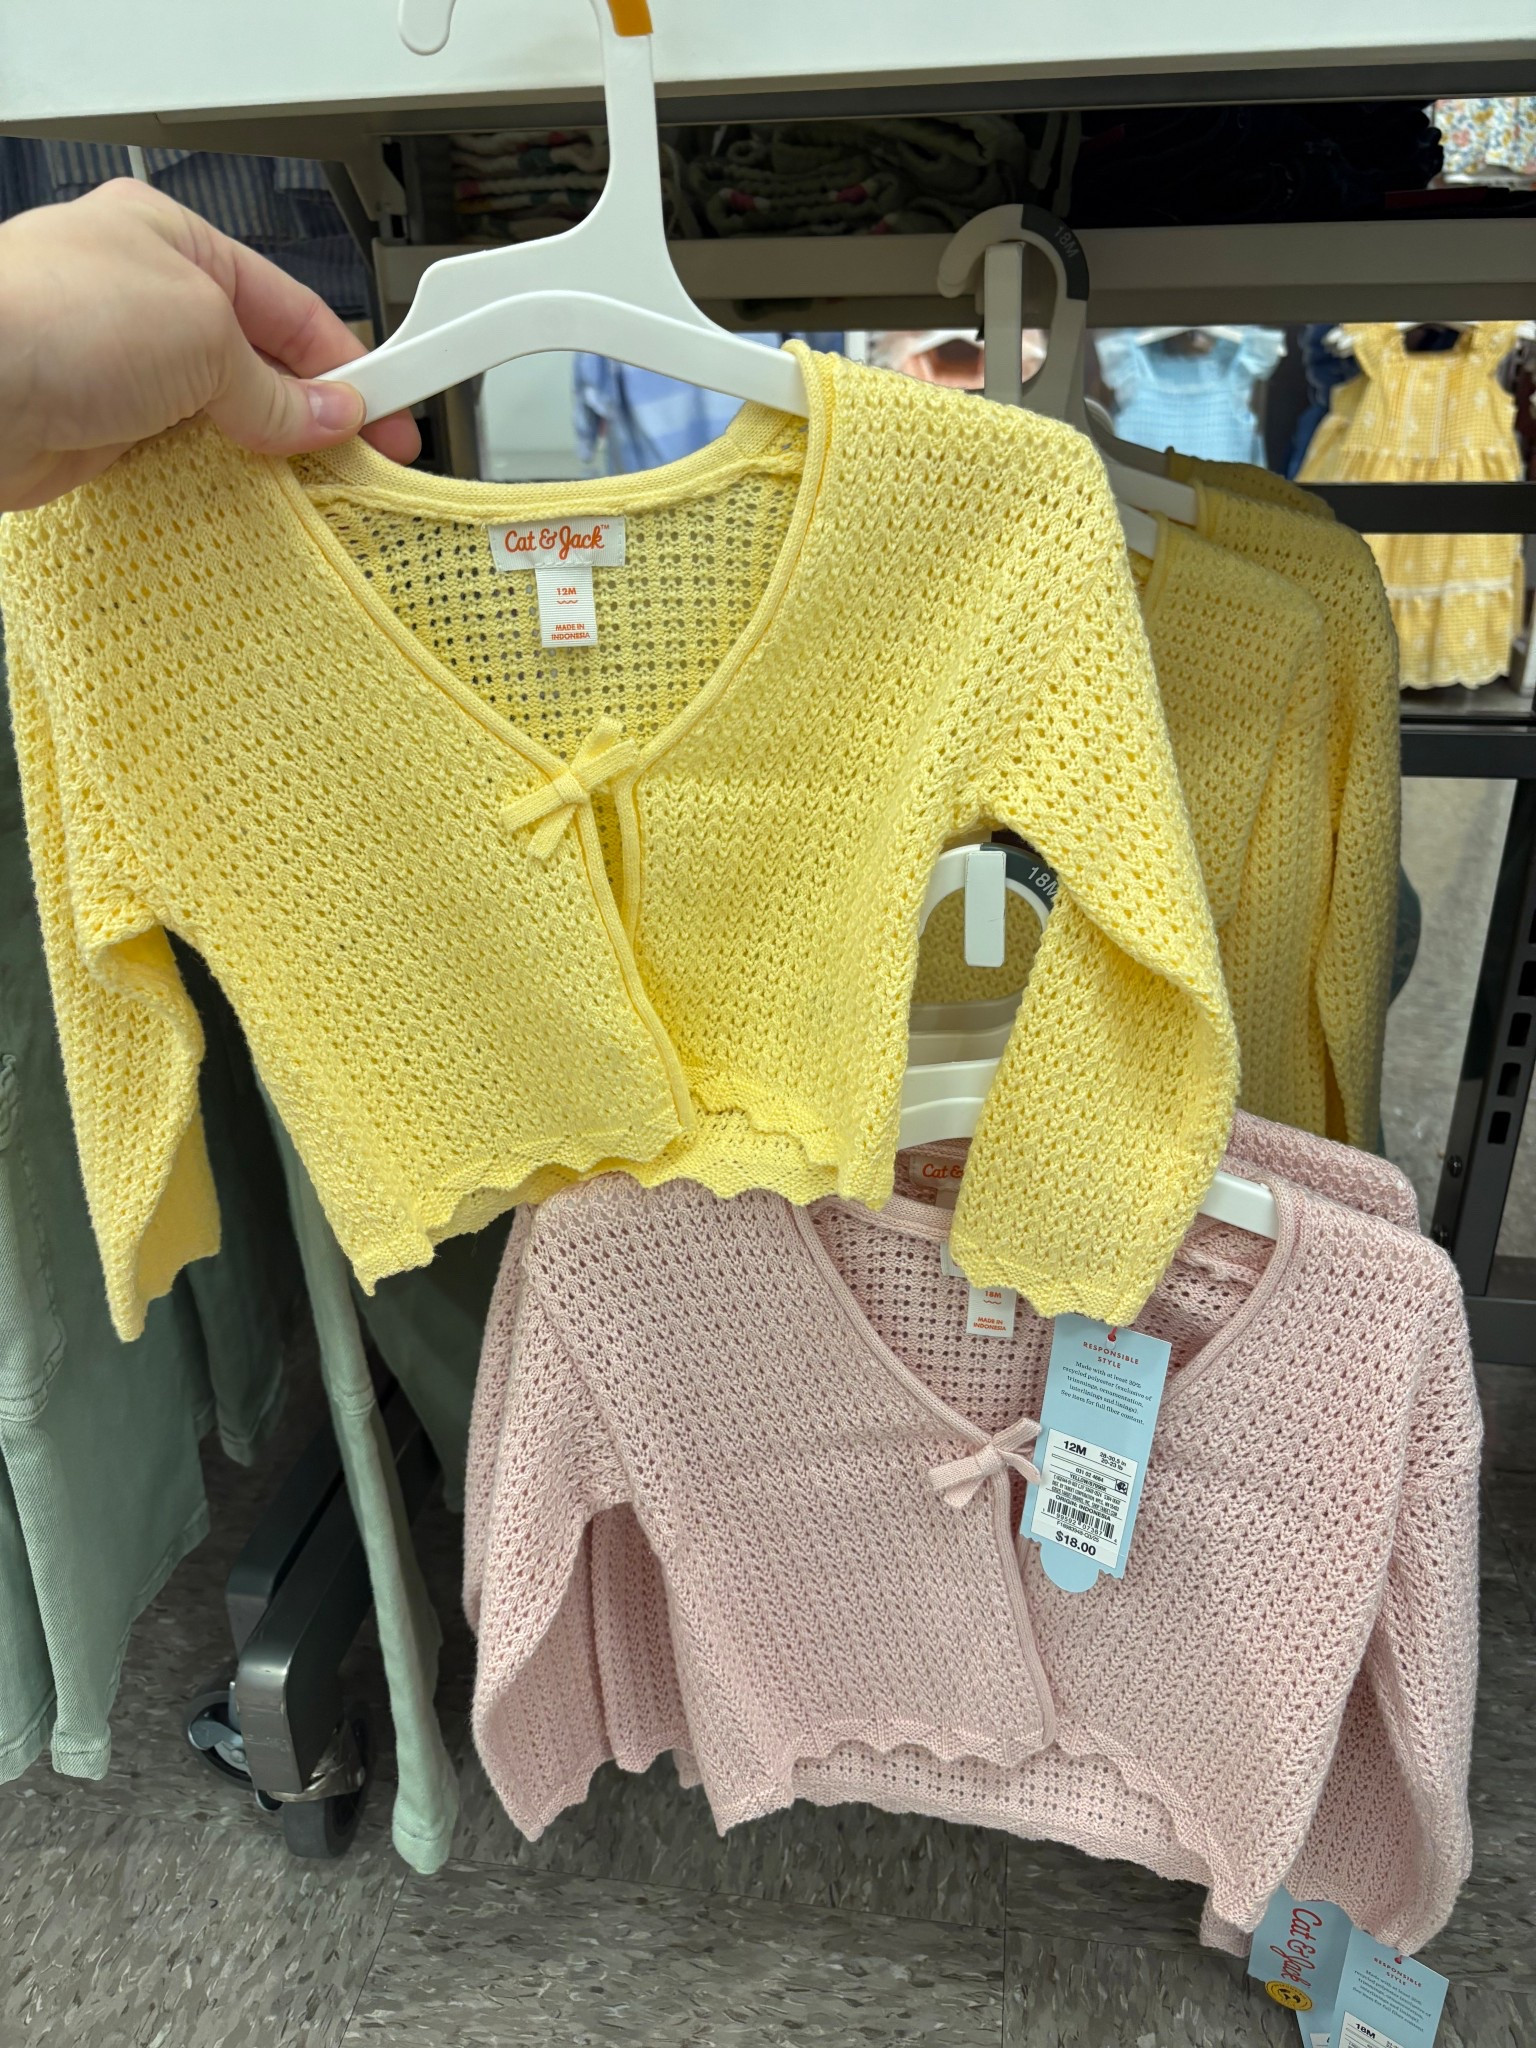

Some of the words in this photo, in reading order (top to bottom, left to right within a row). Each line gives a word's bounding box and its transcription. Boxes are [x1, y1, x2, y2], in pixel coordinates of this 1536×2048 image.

[1054, 226, 1079, 258] 18M
[504, 530, 537, 552] Cat
[538, 528, 557, 550] &
[558, 525, 604, 560] Jack
[1028, 866, 1059, 900] 18M
[922, 1163, 948, 1180] Cat
[950, 1165, 964, 1178] &
[984, 1290, 1002, 1298] 18M
[973, 1322, 1006, 1331] INDONESIA
[977, 1317, 995, 1325] MADE
[1083, 1342, 1139, 1364] RESPONSIBLE
[1098, 1356, 1121, 1368] STYLE
[1063, 1366, 1087, 1378] recycled
[1088, 1375, 1114, 1388] polyester
[1076, 1362, 1092, 1371] Made
[1093, 1368, 1105, 1376] with
[1114, 1374, 1128, 1384] least
[1096, 1402, 1105, 1411] full
[1107, 1406, 1120, 1415] fiber
[1064, 1440, 1087, 1456] 12M
[1056, 1494, 1078, 1507] ORIGIN:
[1079, 1504, 1111, 1521] INDONESIA
[1056, 1530, 1096, 1556] $18.00
[1290, 1908, 1322, 1941] Cat
[1287, 1939, 1316, 1958] &
[1270, 1945, 1315, 1986] Jack
[1374, 1957, 1422, 1988] RESPONSIBLE
[1386, 1971, 1406, 1986] STYLE
[1356, 2023, 1375, 2039] 18M
